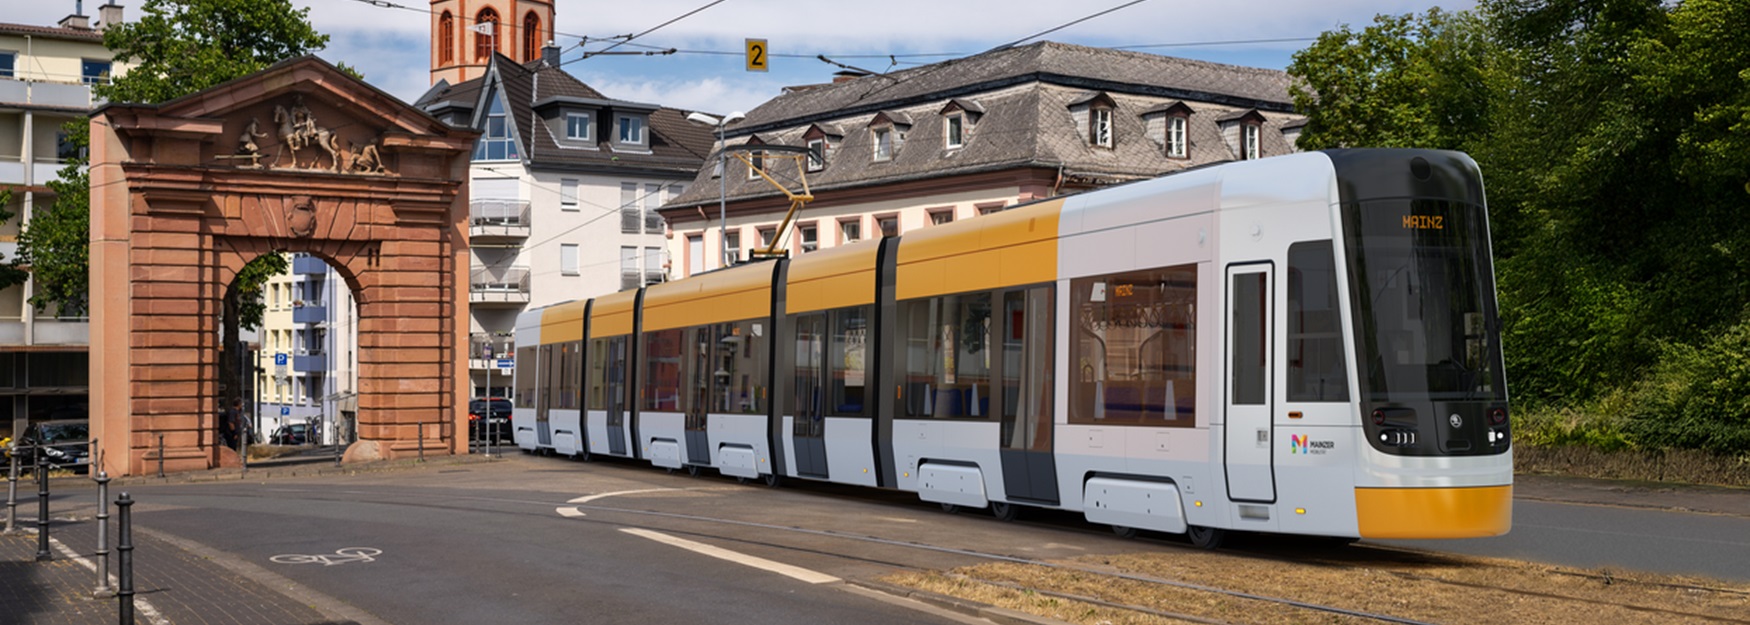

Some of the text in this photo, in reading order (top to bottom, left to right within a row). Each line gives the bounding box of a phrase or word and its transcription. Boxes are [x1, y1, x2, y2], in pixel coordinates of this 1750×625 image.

[752, 45, 763, 65] 2
[1402, 215, 1443, 229] MAINZ
[1291, 434, 1308, 454] M
